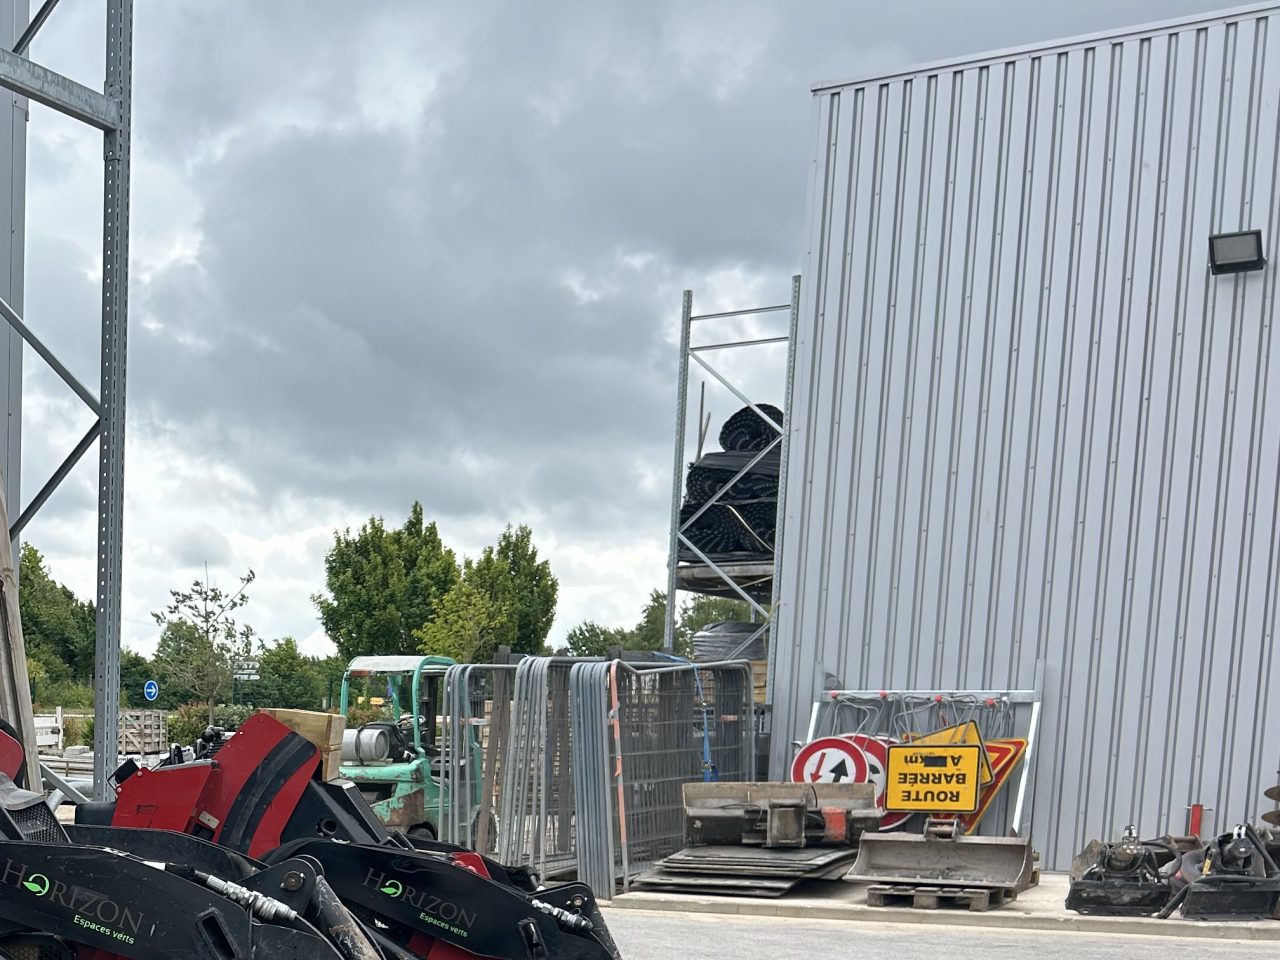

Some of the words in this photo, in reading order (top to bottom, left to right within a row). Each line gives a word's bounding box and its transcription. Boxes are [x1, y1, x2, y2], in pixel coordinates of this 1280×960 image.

[898, 772, 966, 787] BARRÉE
[901, 790, 960, 802] ROUTE
[0, 857, 145, 934] HORIZON
[362, 867, 477, 928] HORIZON
[73, 914, 111, 936] Espaces
[112, 930, 135, 945] verts
[419, 912, 449, 930] Espaces
[450, 925, 468, 938] verts
